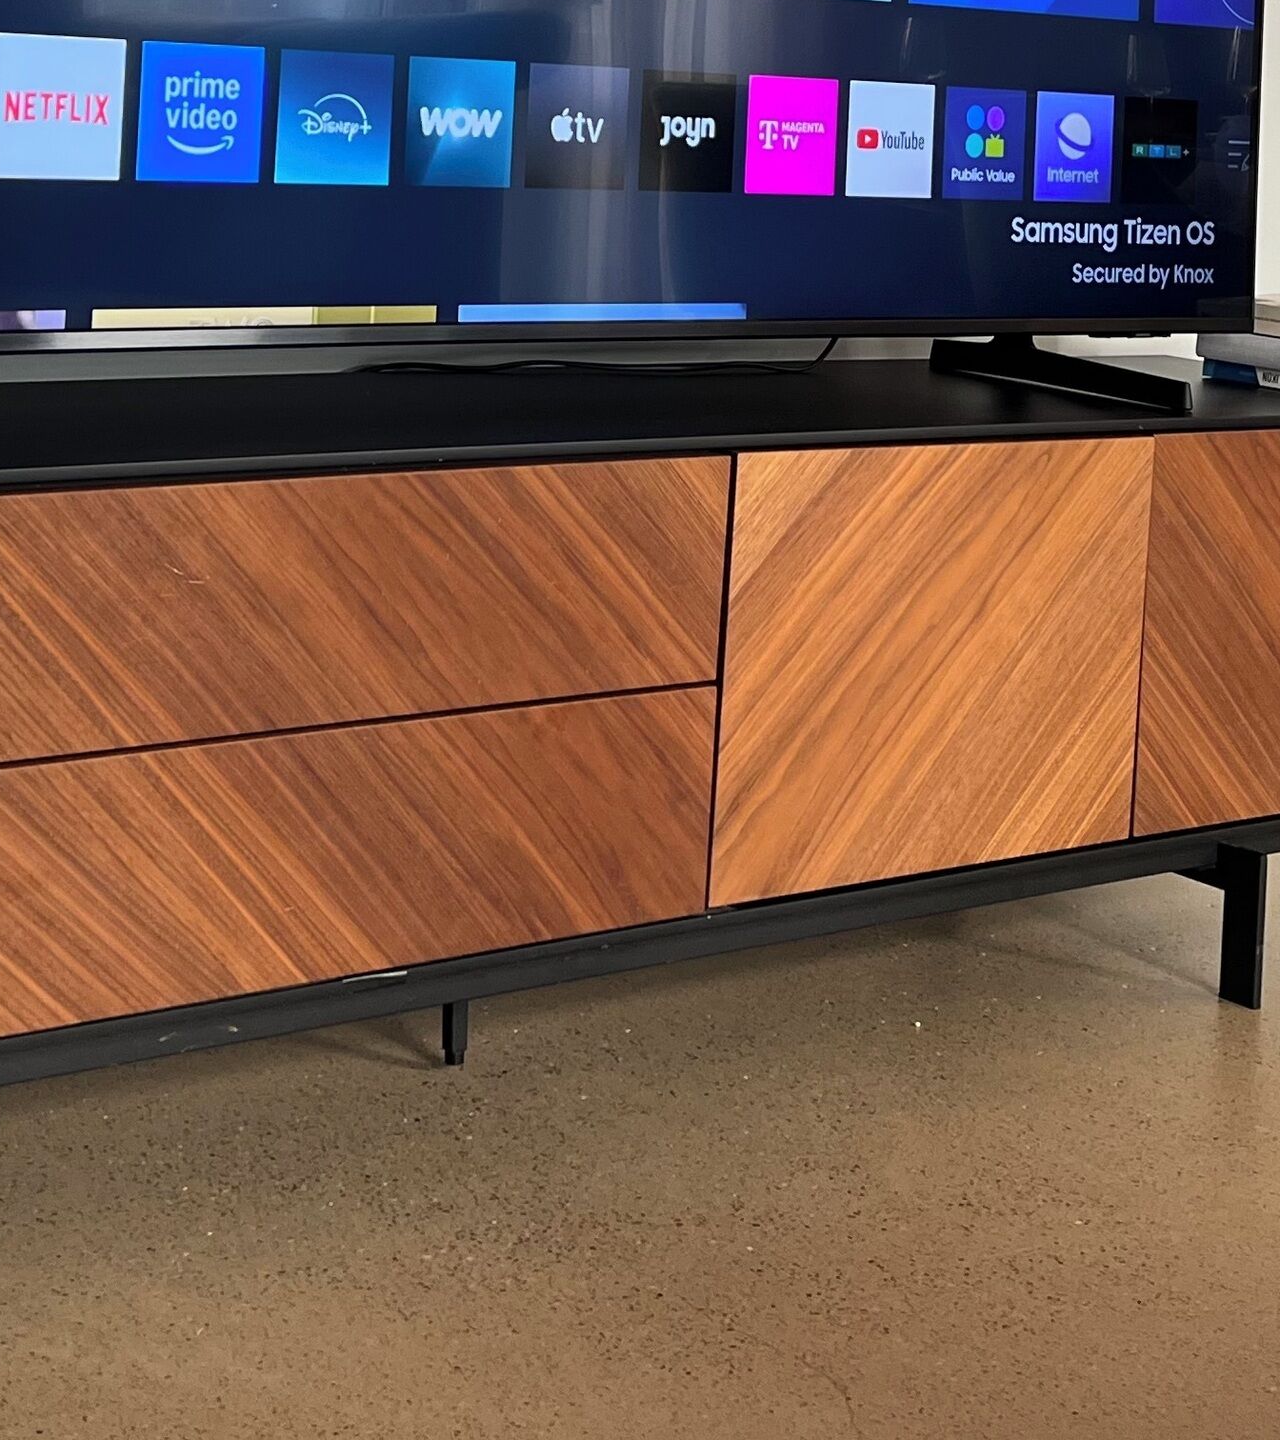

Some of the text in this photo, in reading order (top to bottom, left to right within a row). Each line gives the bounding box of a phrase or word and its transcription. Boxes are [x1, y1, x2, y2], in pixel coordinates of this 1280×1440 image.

[164, 72, 241, 107] prime
[4, 89, 109, 126] NETFLIX
[165, 102, 238, 132] video
[574, 114, 604, 144] tv
[781, 121, 825, 134] MAGENTA
[881, 130, 925, 150] YouTube
[782, 135, 800, 150] TV
[951, 167, 1016, 183] Public Value
[1047, 166, 1099, 184] Internet
[1011, 216, 1216, 252] Samsung Tizen OS
[1072, 262, 1214, 290] Secured by Knox
